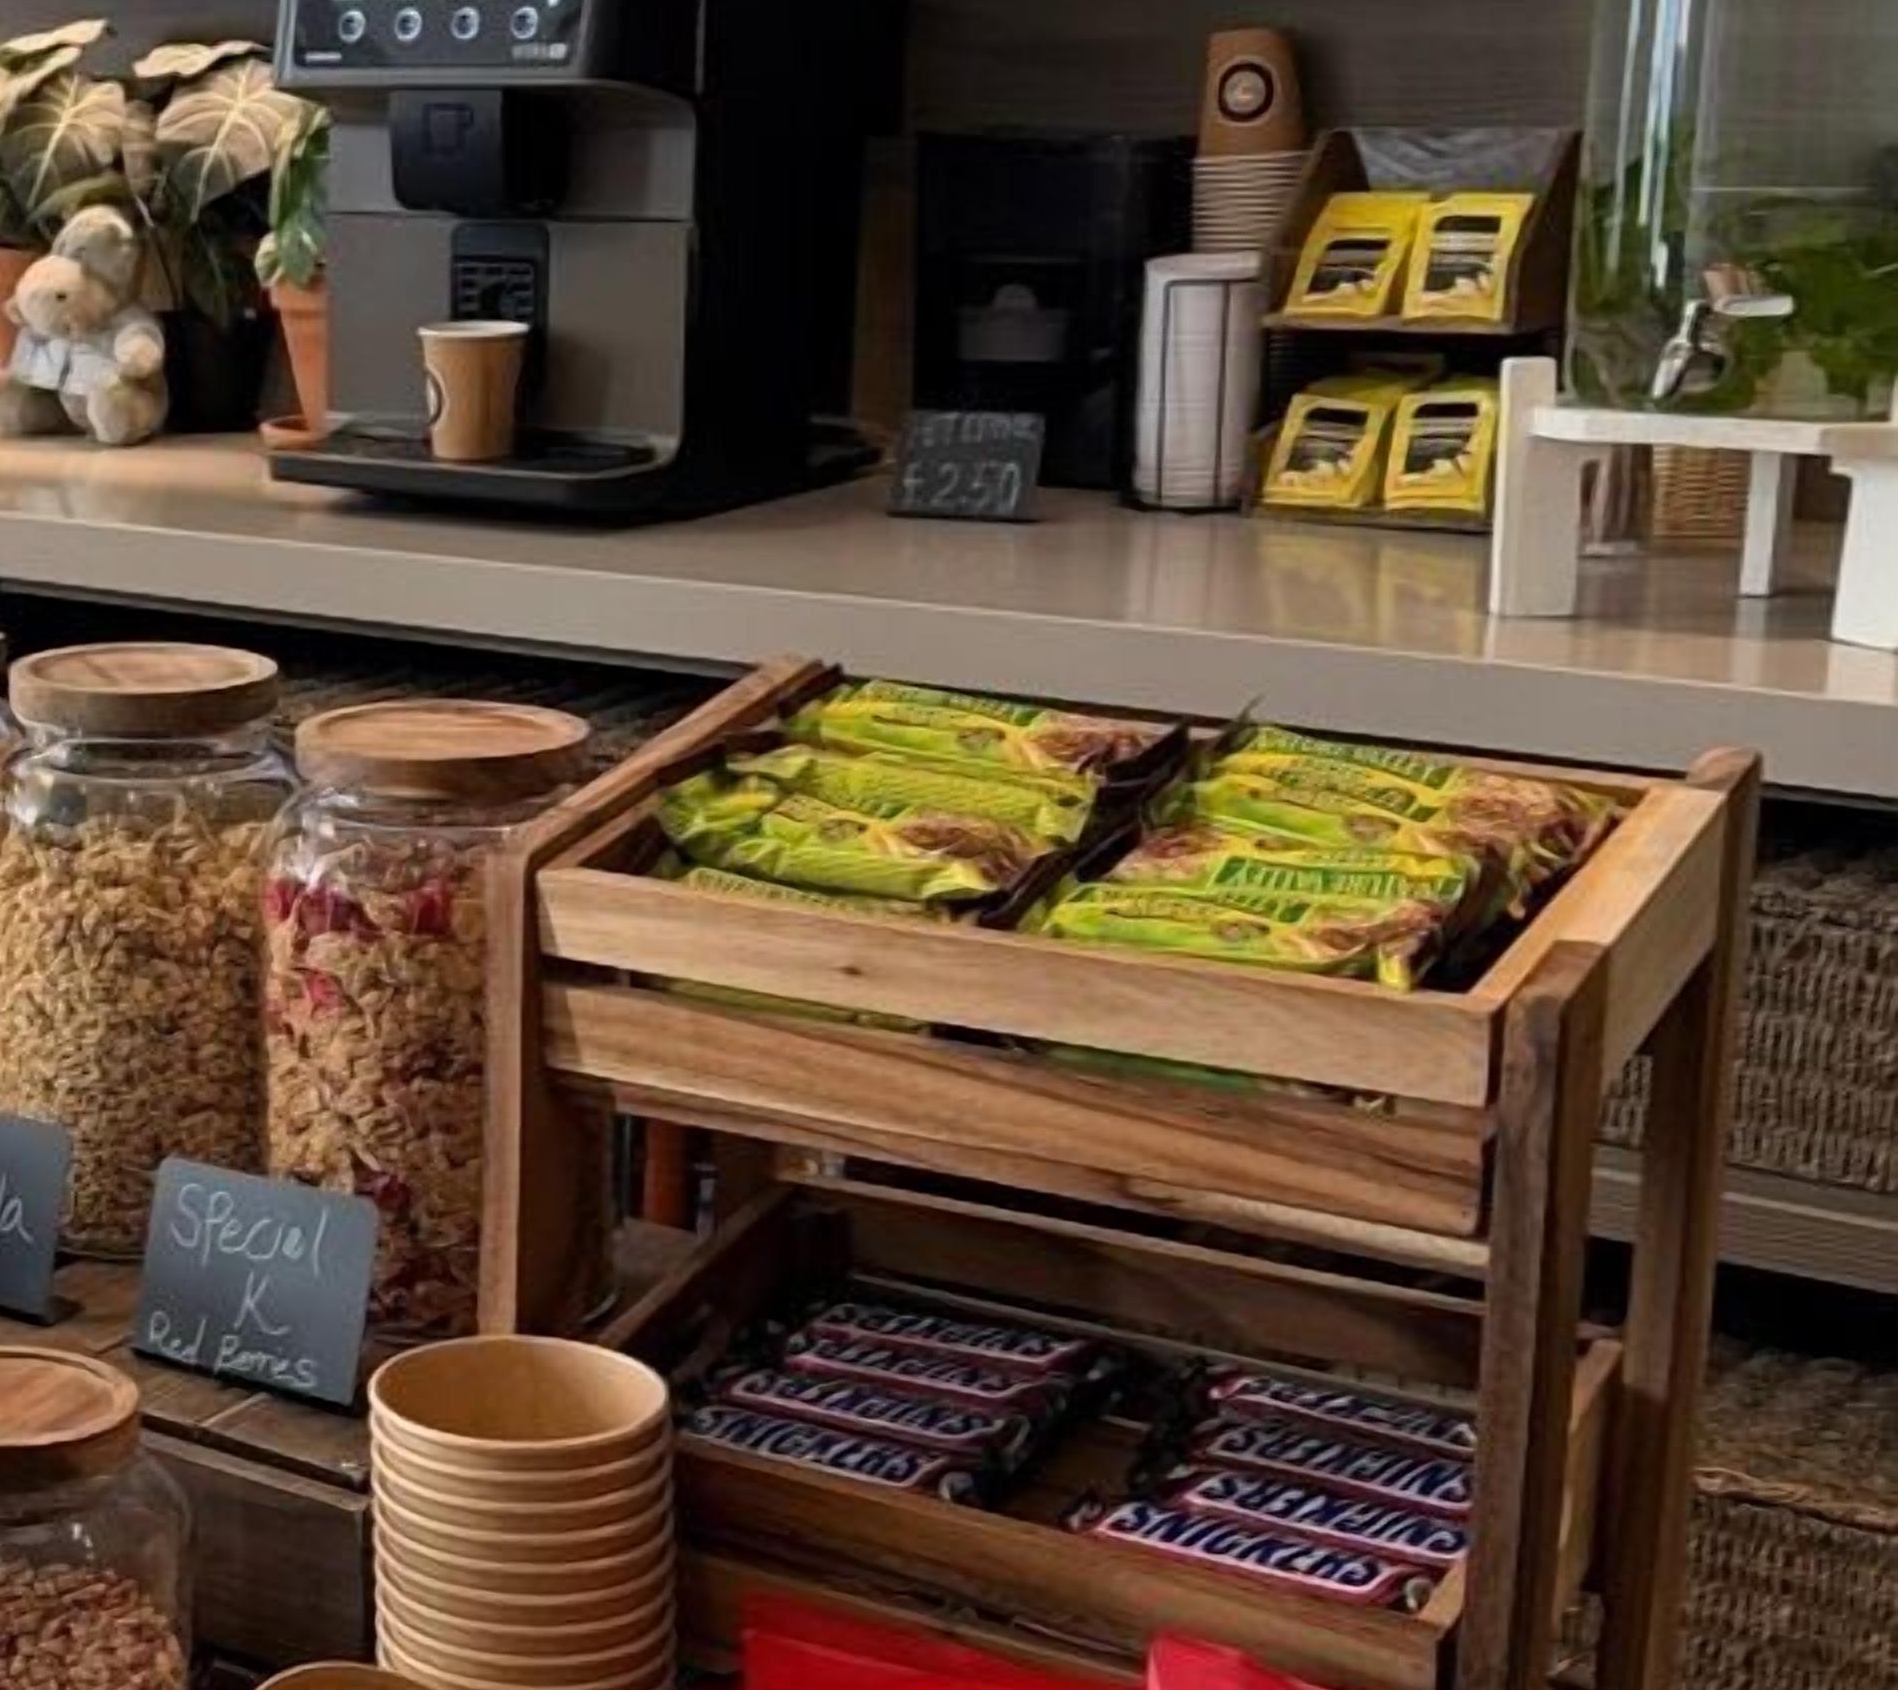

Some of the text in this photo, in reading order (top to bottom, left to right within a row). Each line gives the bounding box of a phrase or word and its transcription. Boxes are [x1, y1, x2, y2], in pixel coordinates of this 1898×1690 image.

[170, 1183, 329, 1276] Special
[233, 1271, 291, 1335] K
[149, 1311, 206, 1362] Red
